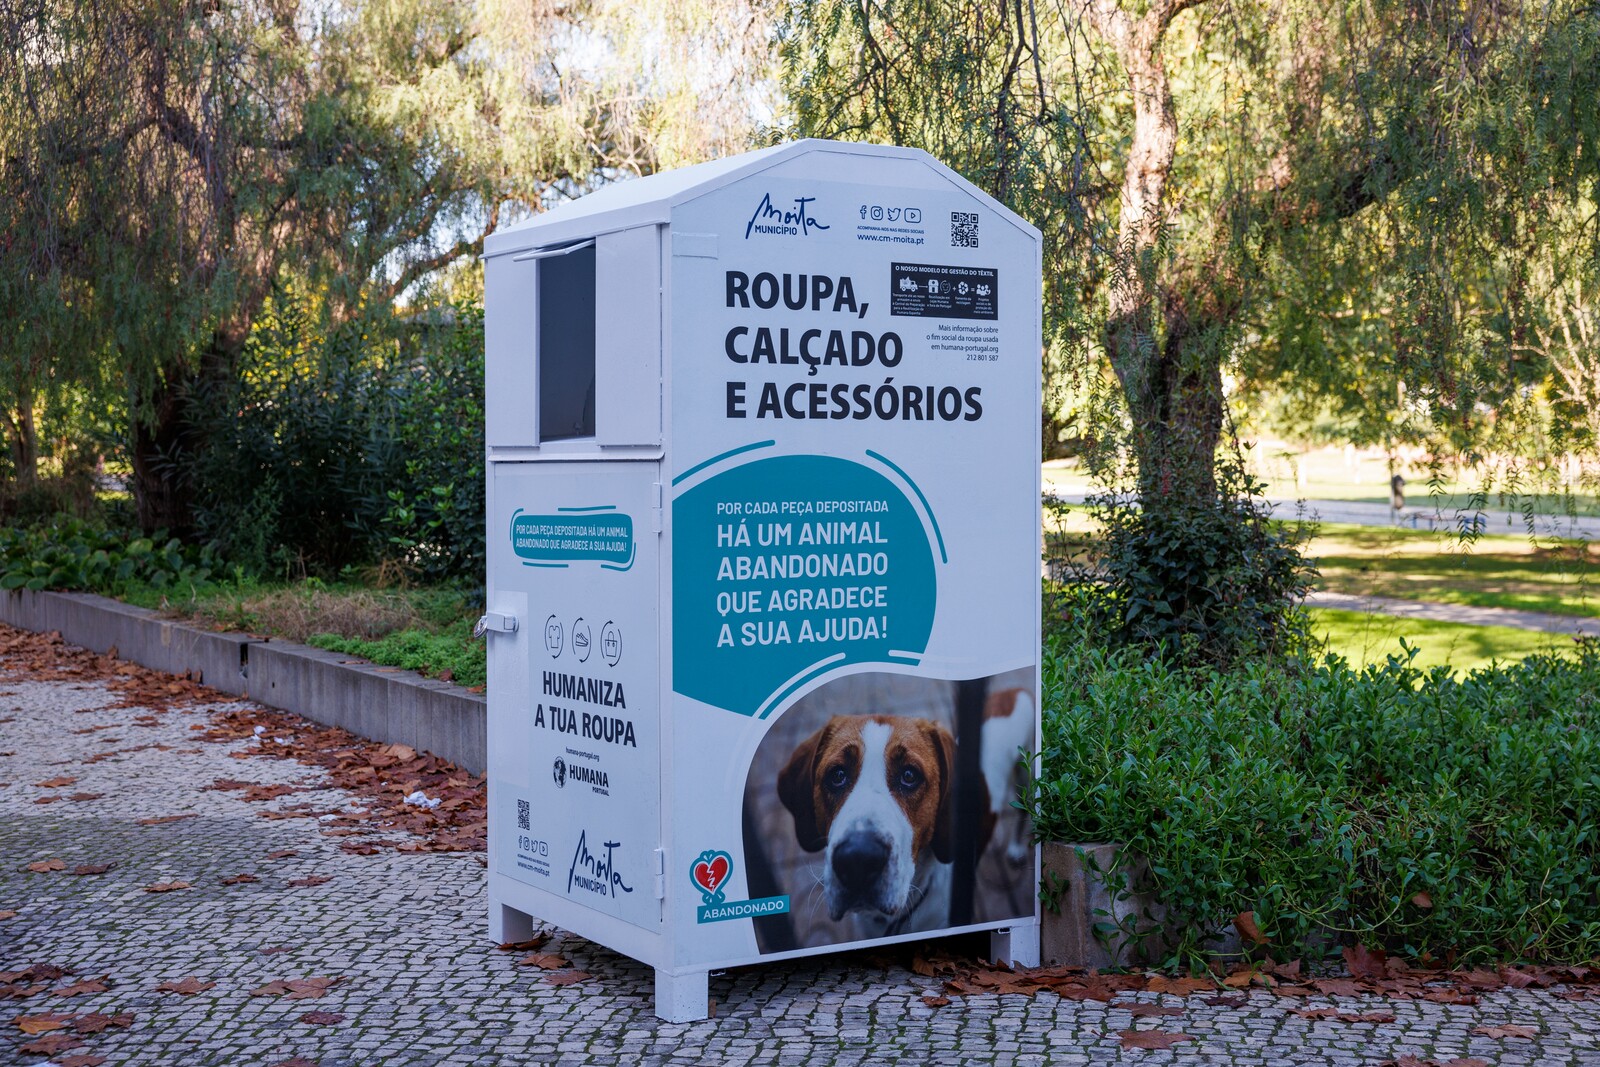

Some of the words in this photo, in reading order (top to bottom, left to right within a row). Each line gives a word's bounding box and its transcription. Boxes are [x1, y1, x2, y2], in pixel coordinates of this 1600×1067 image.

[746, 193, 830, 239] Moita
[754, 222, 798, 236] MUNICÍPIO
[857, 234, 925, 246] www.cm-moita.pt
[725, 270, 869, 319] ROUPA,
[938, 324, 951, 332] Mais
[952, 325, 983, 333] informação
[725, 326, 903, 376] CALÇADO
[941, 344, 999, 353] humana-portugal.org
[726, 381, 746, 419] E
[757, 377, 983, 422] ACESSÓRIOS
[717, 502, 742, 515] POR
[744, 501, 778, 514] CADA
[781, 501, 813, 516] PEÇA
[816, 500, 889, 513] DEPOSITADA
[516, 524, 526, 534] POR
[526, 525, 540, 534] CADA
[540, 525, 553, 537] PEÇA
[554, 525, 587, 536] DEPOSITADA
[588, 524, 596, 537] HÁ
[597, 526, 606, 537] UM
[606, 527, 628, 537] ANIMAL
[516, 538, 550, 548] ABANDONADO
[550, 539, 560, 550] QUE
[561, 540, 588, 551] AGRADECE
[589, 541, 593, 550] A
[594, 541, 605, 551] SUA
[606, 541, 627, 552] AJUDA!
[717, 518, 751, 547] HÁ
[757, 523, 792, 546] UM
[798, 521, 888, 545] ANIMAL
[717, 552, 888, 581] ABANDONADO
[717, 590, 762, 617] QUE
[768, 586, 888, 612] AGRADECE
[717, 623, 735, 648] A
[741, 620, 792, 647] SUA
[798, 615, 888, 643] AJUDA!
[543, 671, 626, 709] HUMANIZA
[534, 704, 546, 729] A
[549, 706, 578, 736] TUA
[582, 712, 637, 748] ROUPA
[569, 764, 609, 788] HUMANA
[568, 829, 633, 899] Moita
[574, 873, 607, 896] MUNICÍPIO
[703, 900, 785, 920] ABANDONADO
